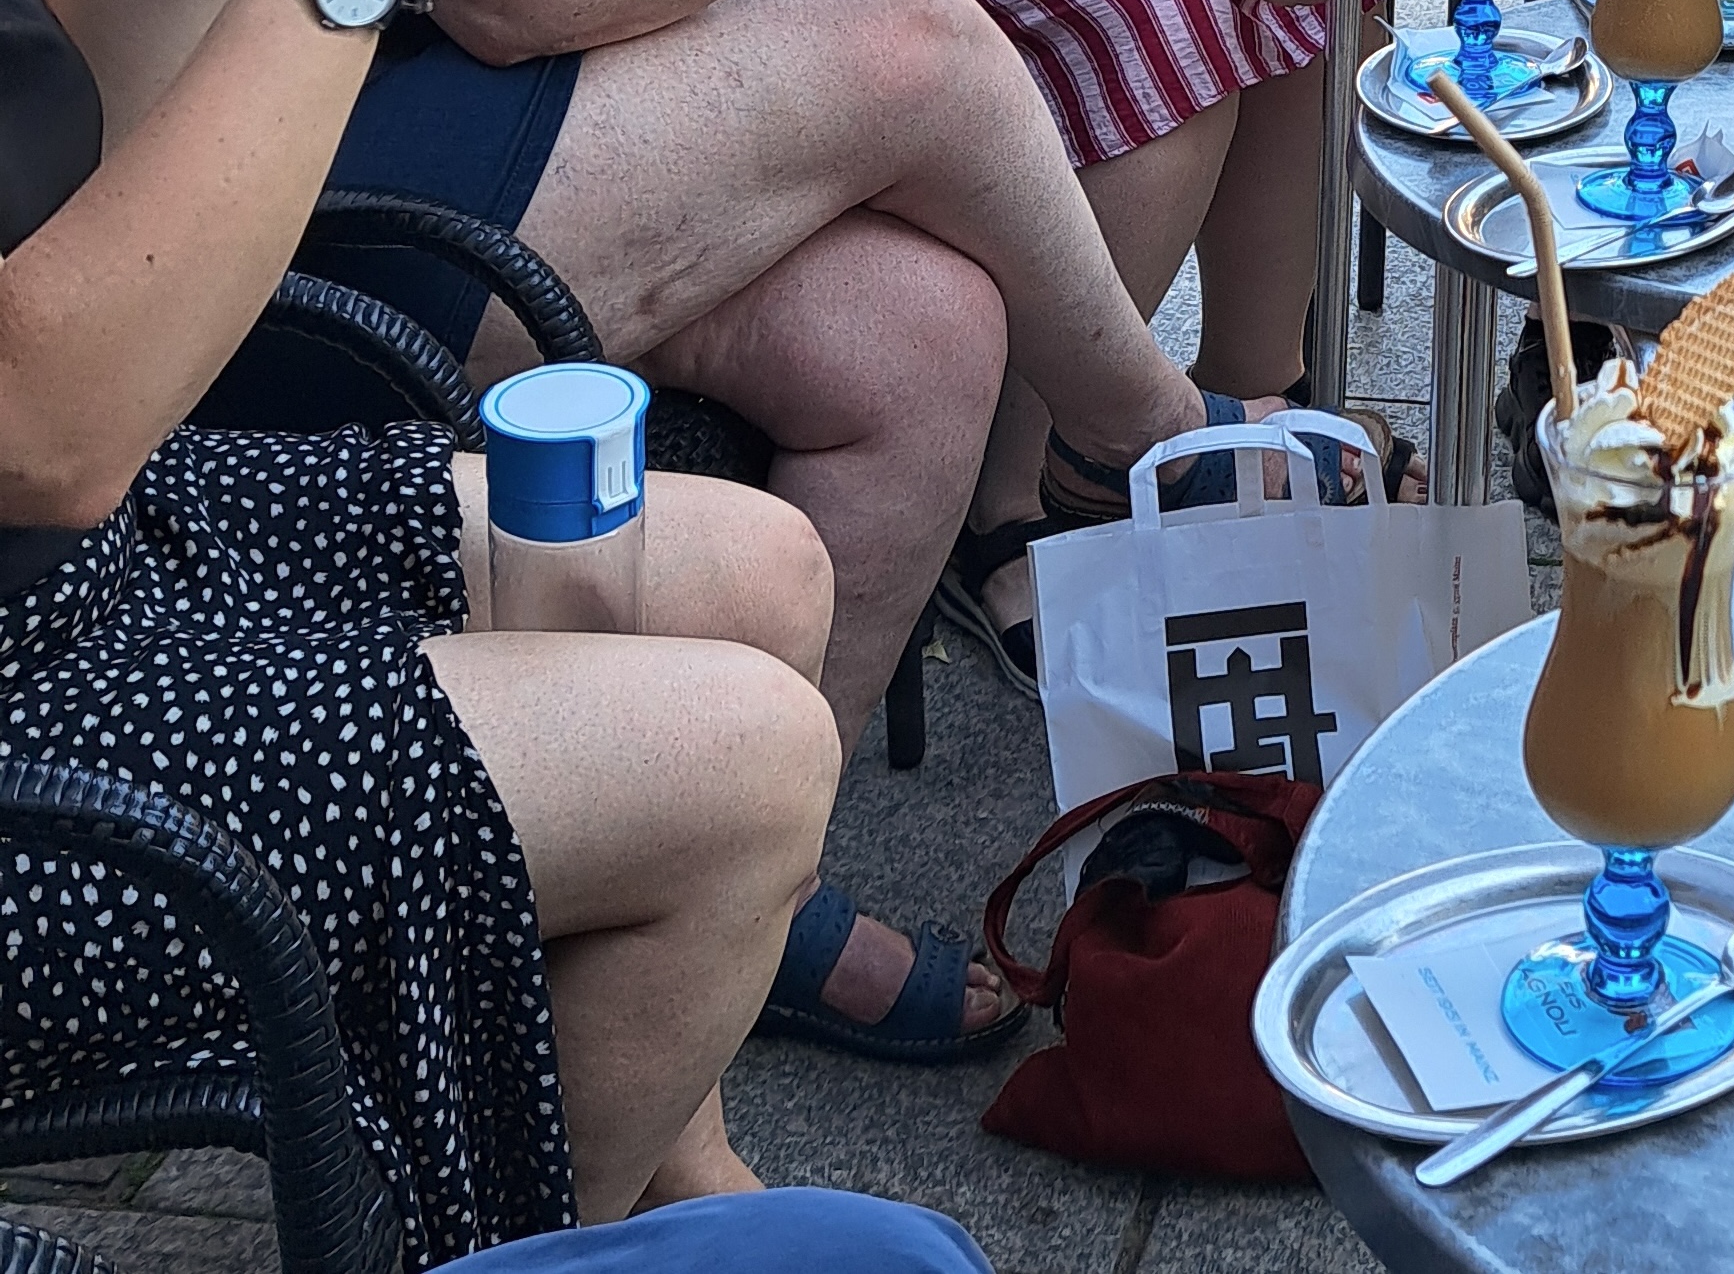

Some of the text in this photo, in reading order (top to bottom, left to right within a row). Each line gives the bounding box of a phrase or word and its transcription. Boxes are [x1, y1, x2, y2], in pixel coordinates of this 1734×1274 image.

[1417, 966, 1446, 997] SEIT
[1452, 1019, 1472, 1039] IN
[1466, 1042, 1500, 1085] MAINZ
[1557, 980, 1587, 1011] EIS
